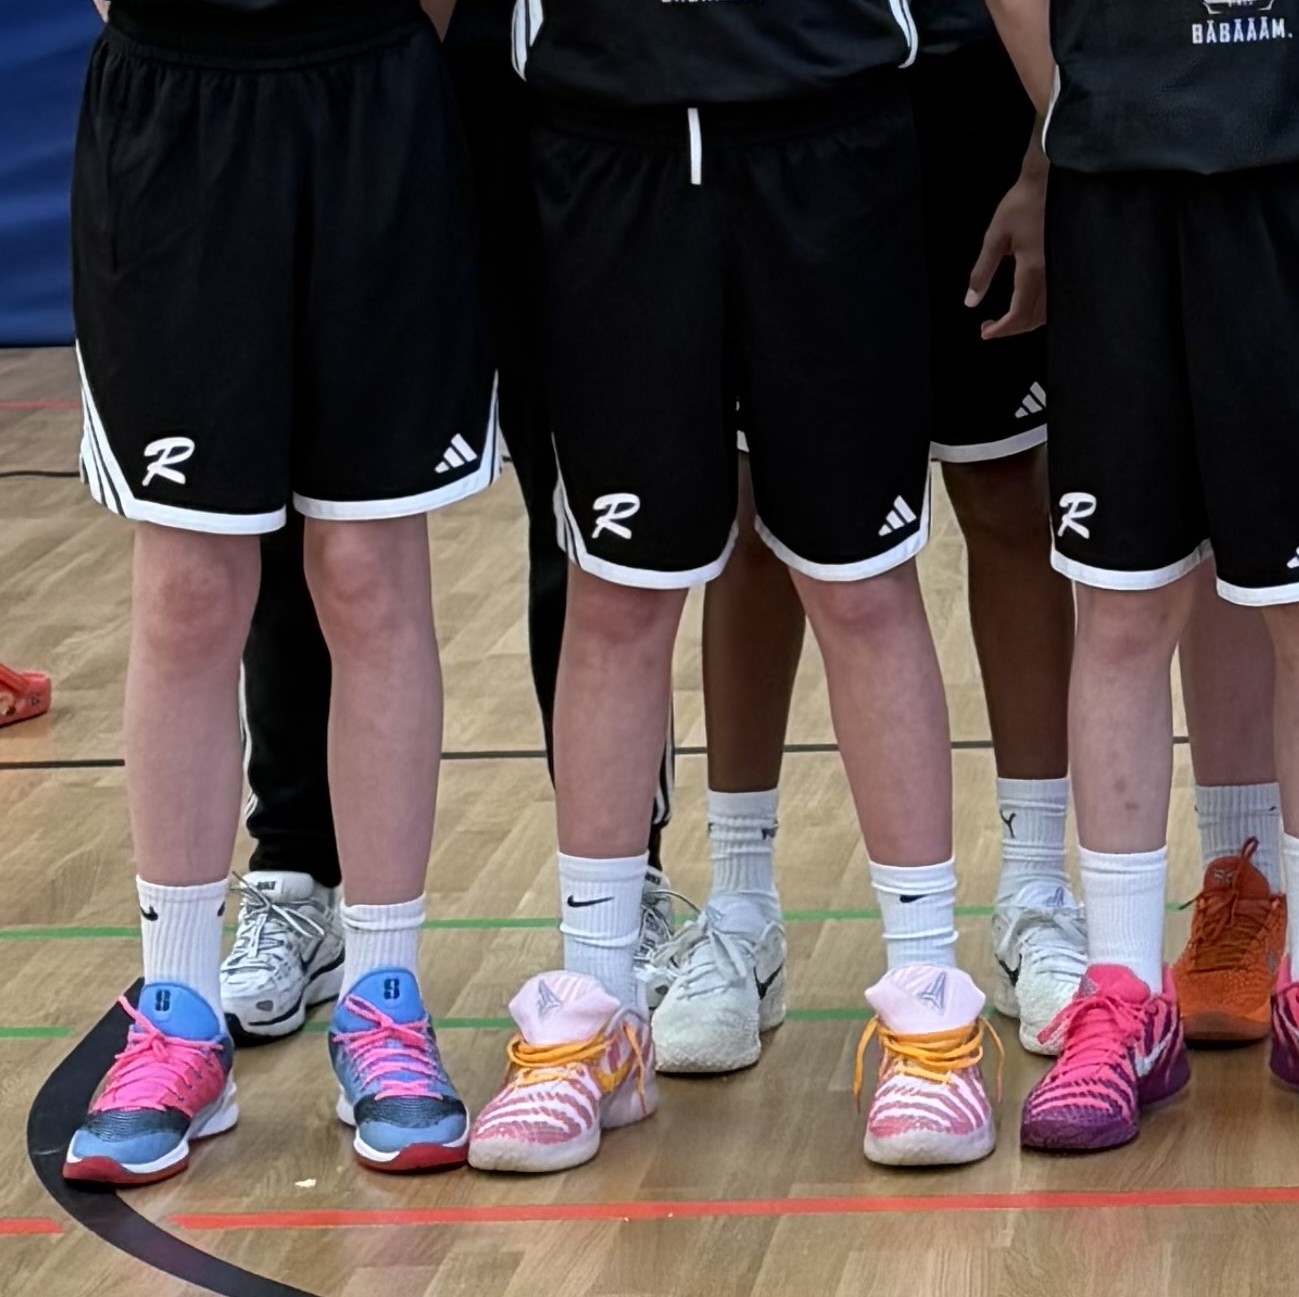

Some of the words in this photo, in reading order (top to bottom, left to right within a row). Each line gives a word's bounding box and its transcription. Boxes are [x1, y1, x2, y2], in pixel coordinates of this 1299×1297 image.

[143, 437, 194, 485] R
[593, 493, 639, 538] R
[1058, 493, 1096, 538] R
